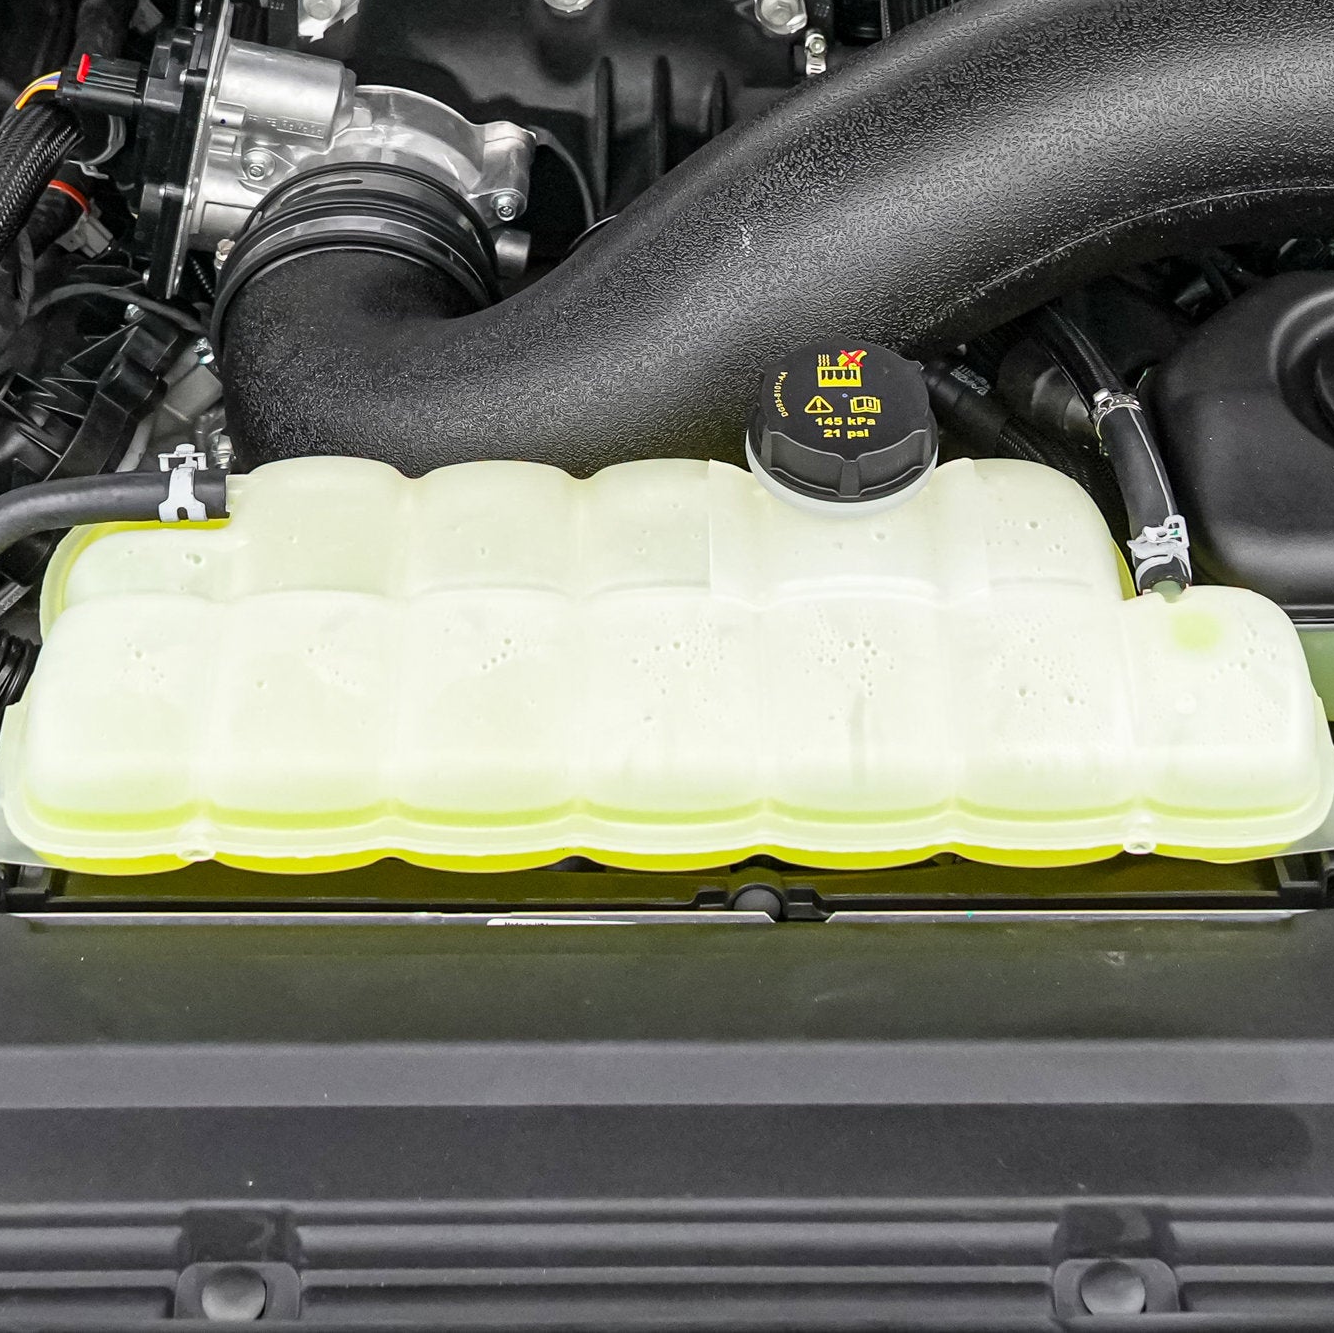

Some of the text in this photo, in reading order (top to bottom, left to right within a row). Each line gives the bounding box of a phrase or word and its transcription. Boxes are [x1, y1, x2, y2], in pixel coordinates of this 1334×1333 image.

[815, 417, 876, 426] 145 kPa
[823, 429, 869, 439] 21 psi
